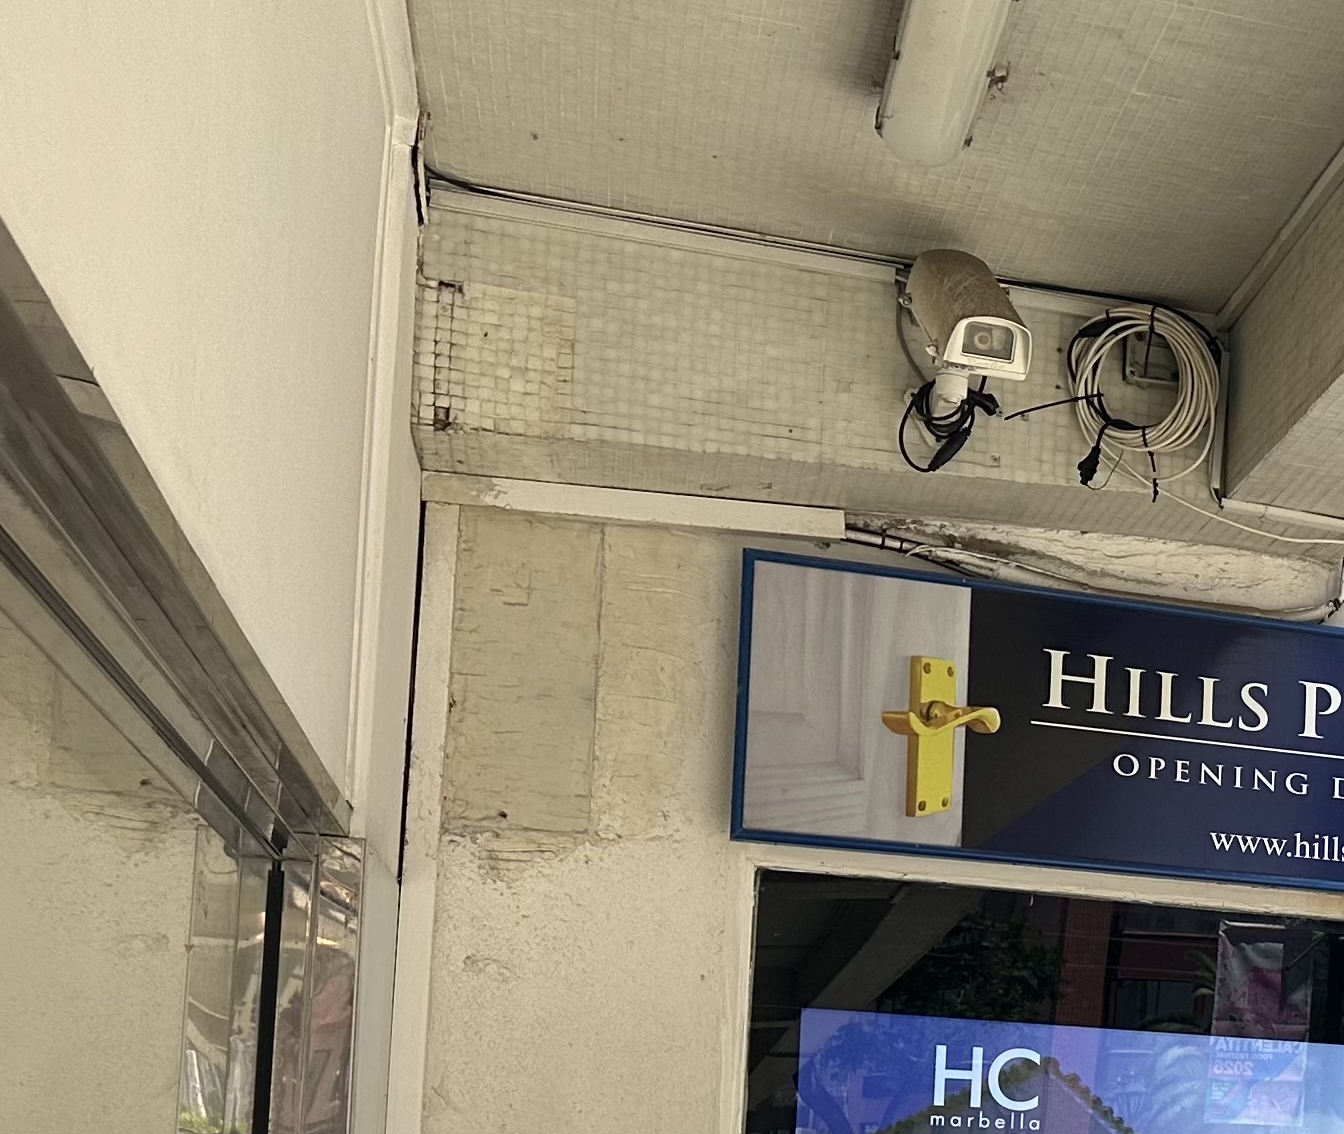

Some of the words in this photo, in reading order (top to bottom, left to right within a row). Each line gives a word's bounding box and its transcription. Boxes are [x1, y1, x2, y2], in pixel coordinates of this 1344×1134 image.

[1042, 648, 1269, 732] HILLS
[1113, 753, 1312, 797] OPENING
[934, 1044, 1040, 1111] HC
[930, 1111, 1040, 1130] marbella
